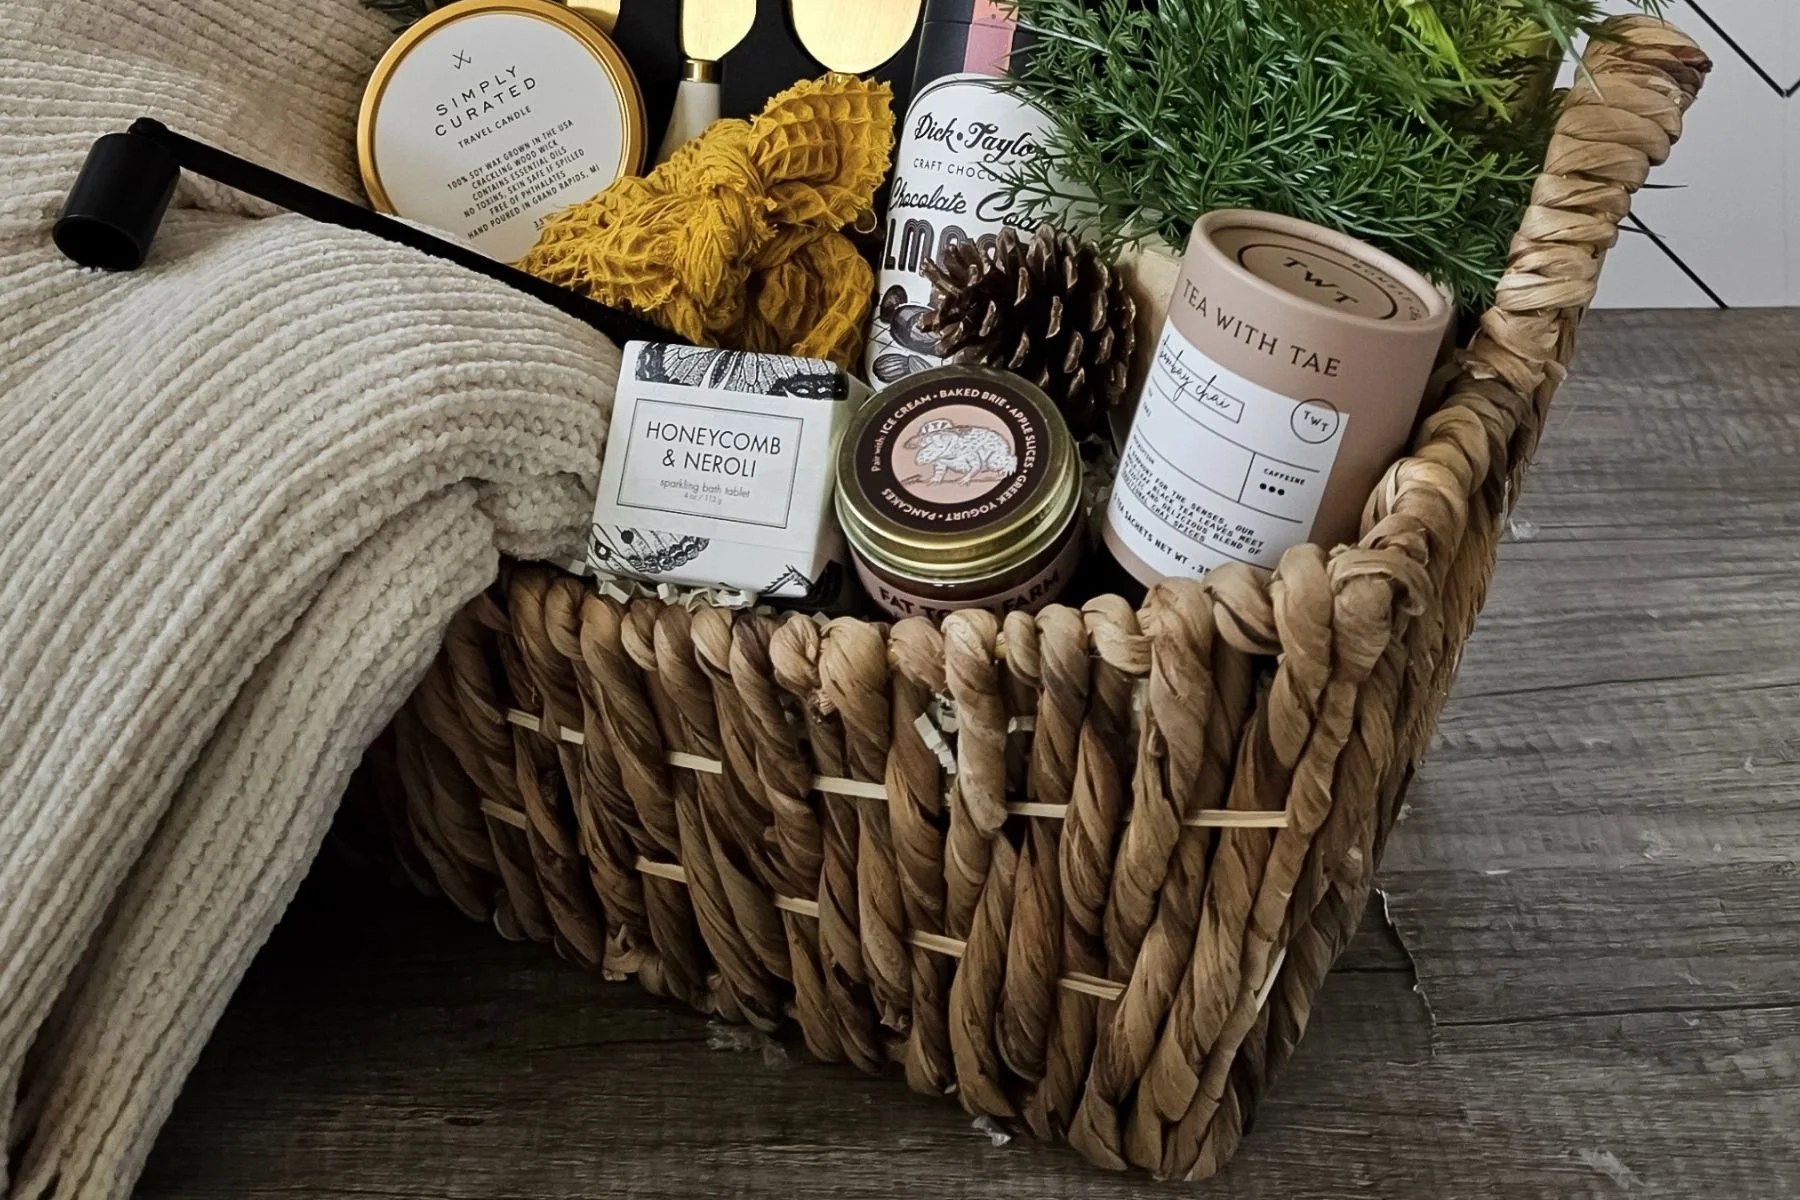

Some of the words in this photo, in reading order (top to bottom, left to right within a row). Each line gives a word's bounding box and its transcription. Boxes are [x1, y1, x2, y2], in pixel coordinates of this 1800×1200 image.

[435, 77, 537, 136] CURATED
[436, 66, 518, 116] SIMPLY
[458, 126, 492, 148] TRAVEL
[495, 106, 532, 129] CANDLE
[914, 112, 959, 153] Dick
[964, 122, 1046, 165] Taylo
[447, 176, 468, 191] 100%
[469, 167, 484, 179] SOY
[485, 158, 501, 170] WAX
[503, 142, 531, 160] GROWN
[532, 137, 541, 145] IN
[542, 128, 557, 140] THE
[558, 119, 574, 132] USA
[472, 164, 513, 189] CRACKLING
[514, 150, 537, 167] WOOD
[539, 139, 558, 154] WICK
[472, 177, 509, 201] CONTAINS
[510, 157, 549, 182] ESSENTIAL
[550, 146, 567, 160] OILS
[914, 158, 941, 172] CRAFT
[947, 164, 1014, 182] CHOCO
[464, 209, 475, 218] NO
[476, 191, 507, 212] TOXINS,
[507, 180, 526, 195] SKIN
[528, 168, 545, 184] SAFE
[547, 164, 554, 173] IF
[555, 148, 585, 169] SPILLED
[467, 223, 489, 240] HAND
[490, 207, 521, 227] POURED
[522, 201, 531, 211] IN
[532, 186, 558, 205] GRAND
[559, 171, 589, 190] RAPIDS,
[589, 163, 600, 174] MI
[489, 201, 508, 216] FREE
[509, 195, 520, 205] OF
[520, 170, 566, 199] PHTHALATES
[890, 177, 967, 214] Chocolate
[1284, 256, 1359, 304] TWT
[1183, 279, 1207, 318] TEA
[1216, 307, 1278, 355] WITH
[1290, 345, 1341, 378] TAE
[895, 394, 932, 419] CREAM
[939, 388, 980, 398] BAKED
[981, 391, 1008, 407] BRIE
[646, 421, 781, 455] HONEYCOMB
[880, 418, 897, 435] ICE
[1009, 407, 1032, 436] APPLE
[1304, 410, 1329, 432] TWT
[662, 449, 675, 468] &
[684, 452, 757, 478] NEROLI
[871, 455, 882, 472] Pair
[1025, 435, 1037, 469] SLICES
[660, 479, 700, 494] sparkling
[702, 482, 722, 494] bath
[725, 486, 751, 498] tablet
[996, 475, 1027, 504] GREEK
[1263, 468, 1306, 485] CAFFEINE
[881, 488, 936, 521] PANCAKES
[943, 502, 998, 522] YOGURT
[1146, 490, 1159, 503] AND
[1161, 503, 1208, 538] DELICIOUS
[1213, 533, 1243, 550] BLEND
[1248, 548, 1263, 556] OF
[1151, 504, 1169, 521] CHAI
[1174, 520, 1206, 542] SPICES
[1152, 485, 1174, 504] BLACK
[1178, 504, 1194, 518] TEA
[1199, 517, 1234, 537] LEAVES
[1239, 535, 1264, 548] MEET
[1155, 478, 1168, 491] FOR
[1172, 491, 1186, 503] THE
[1191, 503, 1228, 528] SENSES,
[1235, 525, 1255, 537] OUR
[1124, 511, 1153, 542] SACHETS
[1155, 539, 1172, 555] NET
[1175, 552, 1189, 564] WT
[879, 586, 915, 614] FAT
[1003, 568, 1060, 614] FARM
